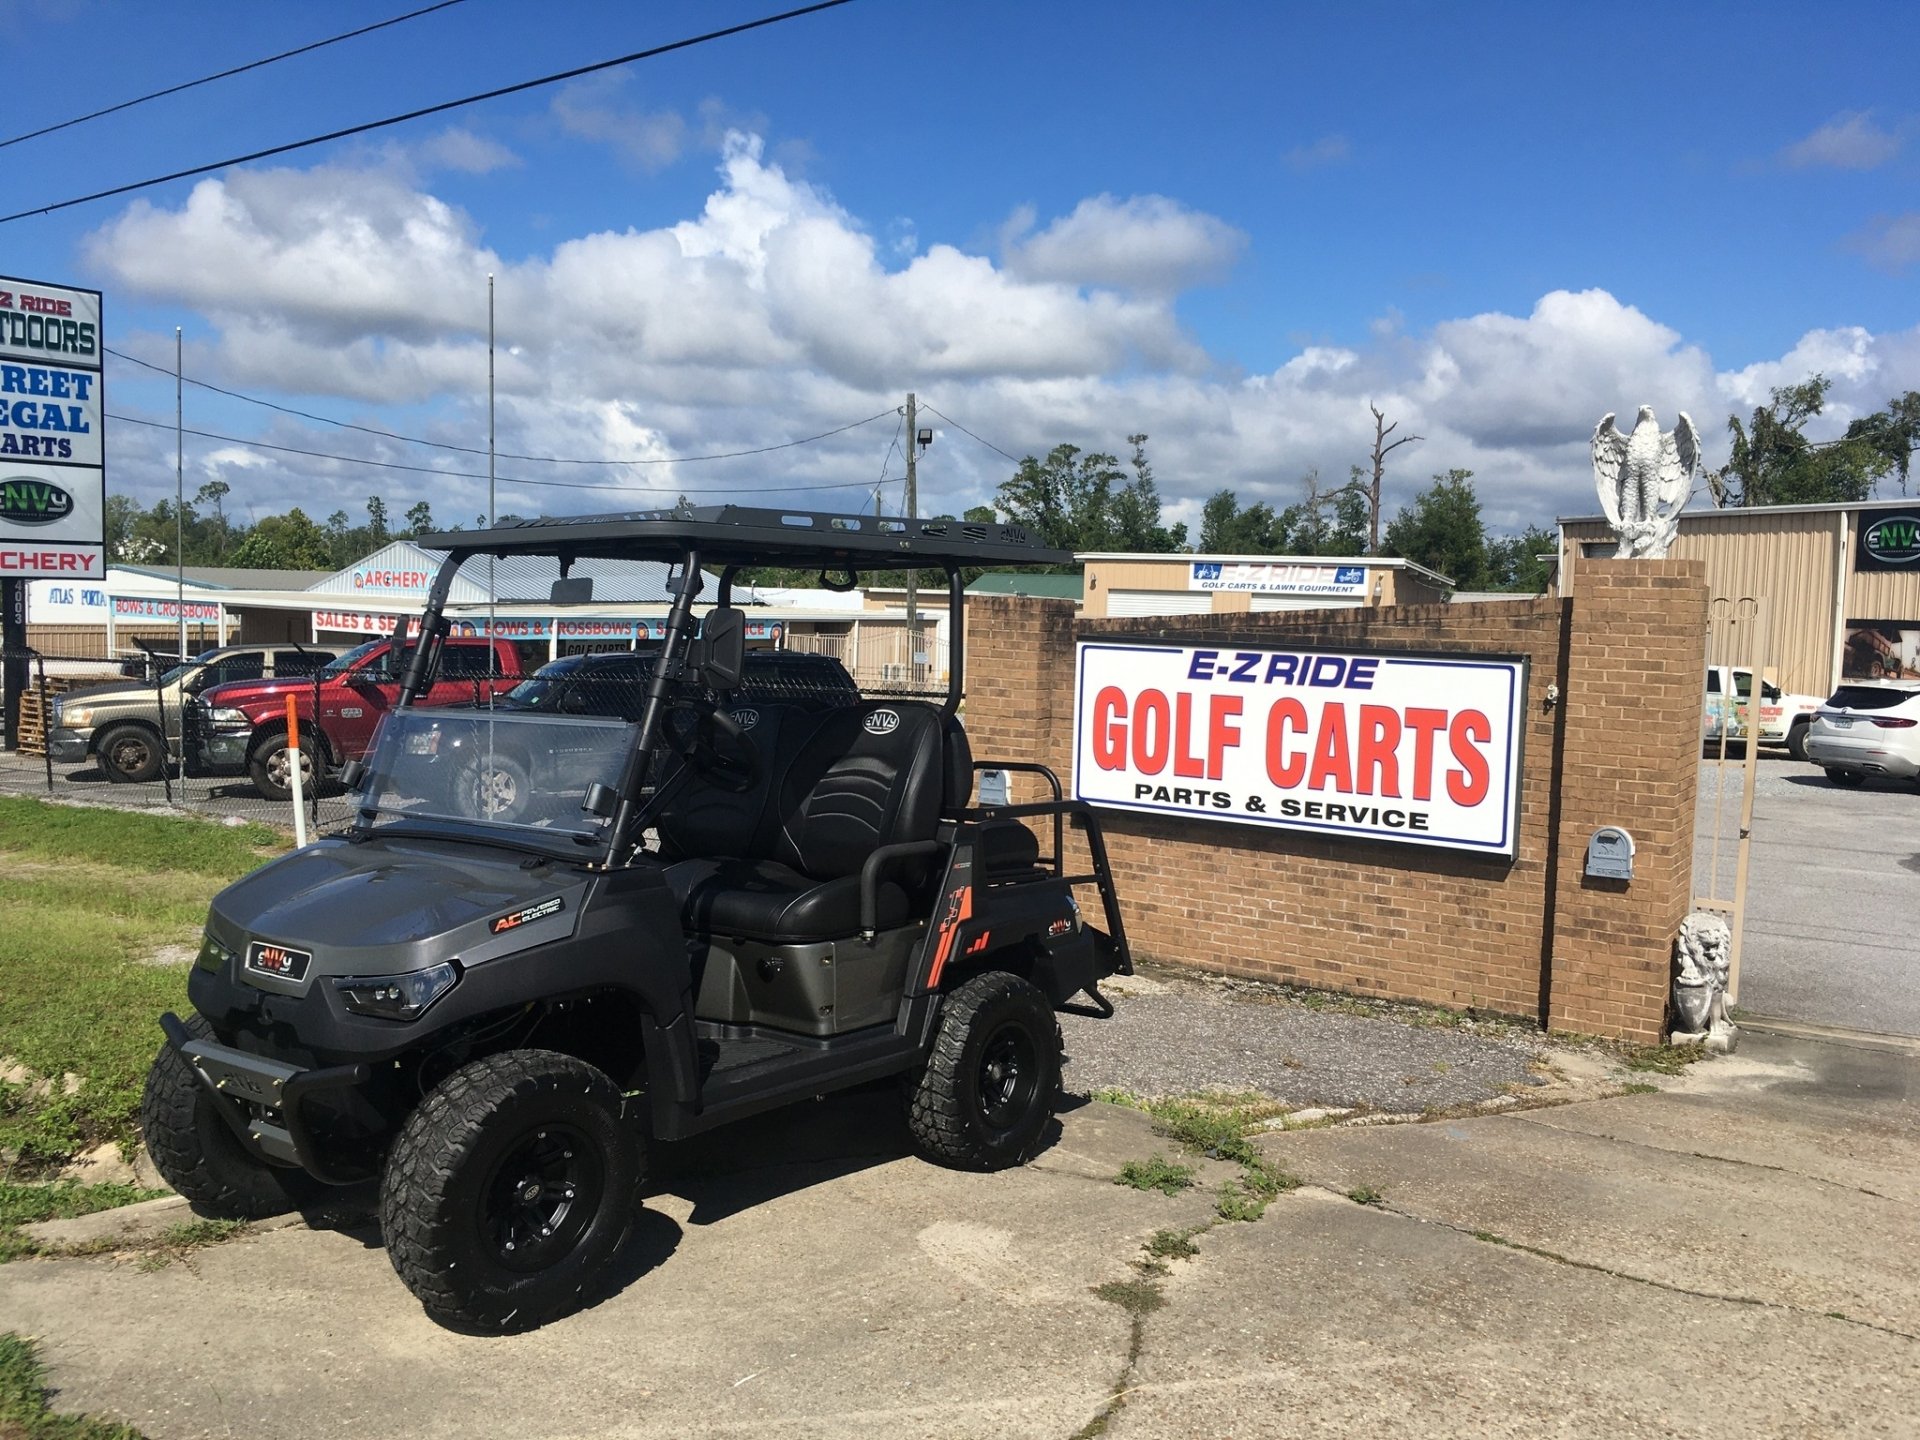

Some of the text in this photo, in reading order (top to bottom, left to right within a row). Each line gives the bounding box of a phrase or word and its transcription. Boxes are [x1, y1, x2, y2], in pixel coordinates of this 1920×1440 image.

[20, 295, 72, 317] RIDE
[1, 365, 92, 400] REET
[1, 433, 72, 458] ARTS
[0, 552, 96, 571] CHERY
[365, 570, 428, 588] ARCHERY
[1221, 564, 1337, 583] E-Z RIDE
[49, 587, 74, 605] ATLAS
[1298, 585, 1355, 593] EQUIPMENT
[115, 598, 143, 614] BOWS
[146, 601, 153, 615] &
[316, 611, 359, 629] SALES
[363, 614, 373, 630] &
[485, 621, 528, 635] BOWS
[533, 621, 543, 635] &
[1187, 650, 1380, 690] E-Z RIDE
[1093, 685, 1492, 808] GOLF CARTS
[1135, 784, 1430, 831] PARTS & SERVICE
[521, 898, 561, 917] POWERED
[521, 905, 559, 922] ELECTRIC
[494, 912, 522, 932] AC
